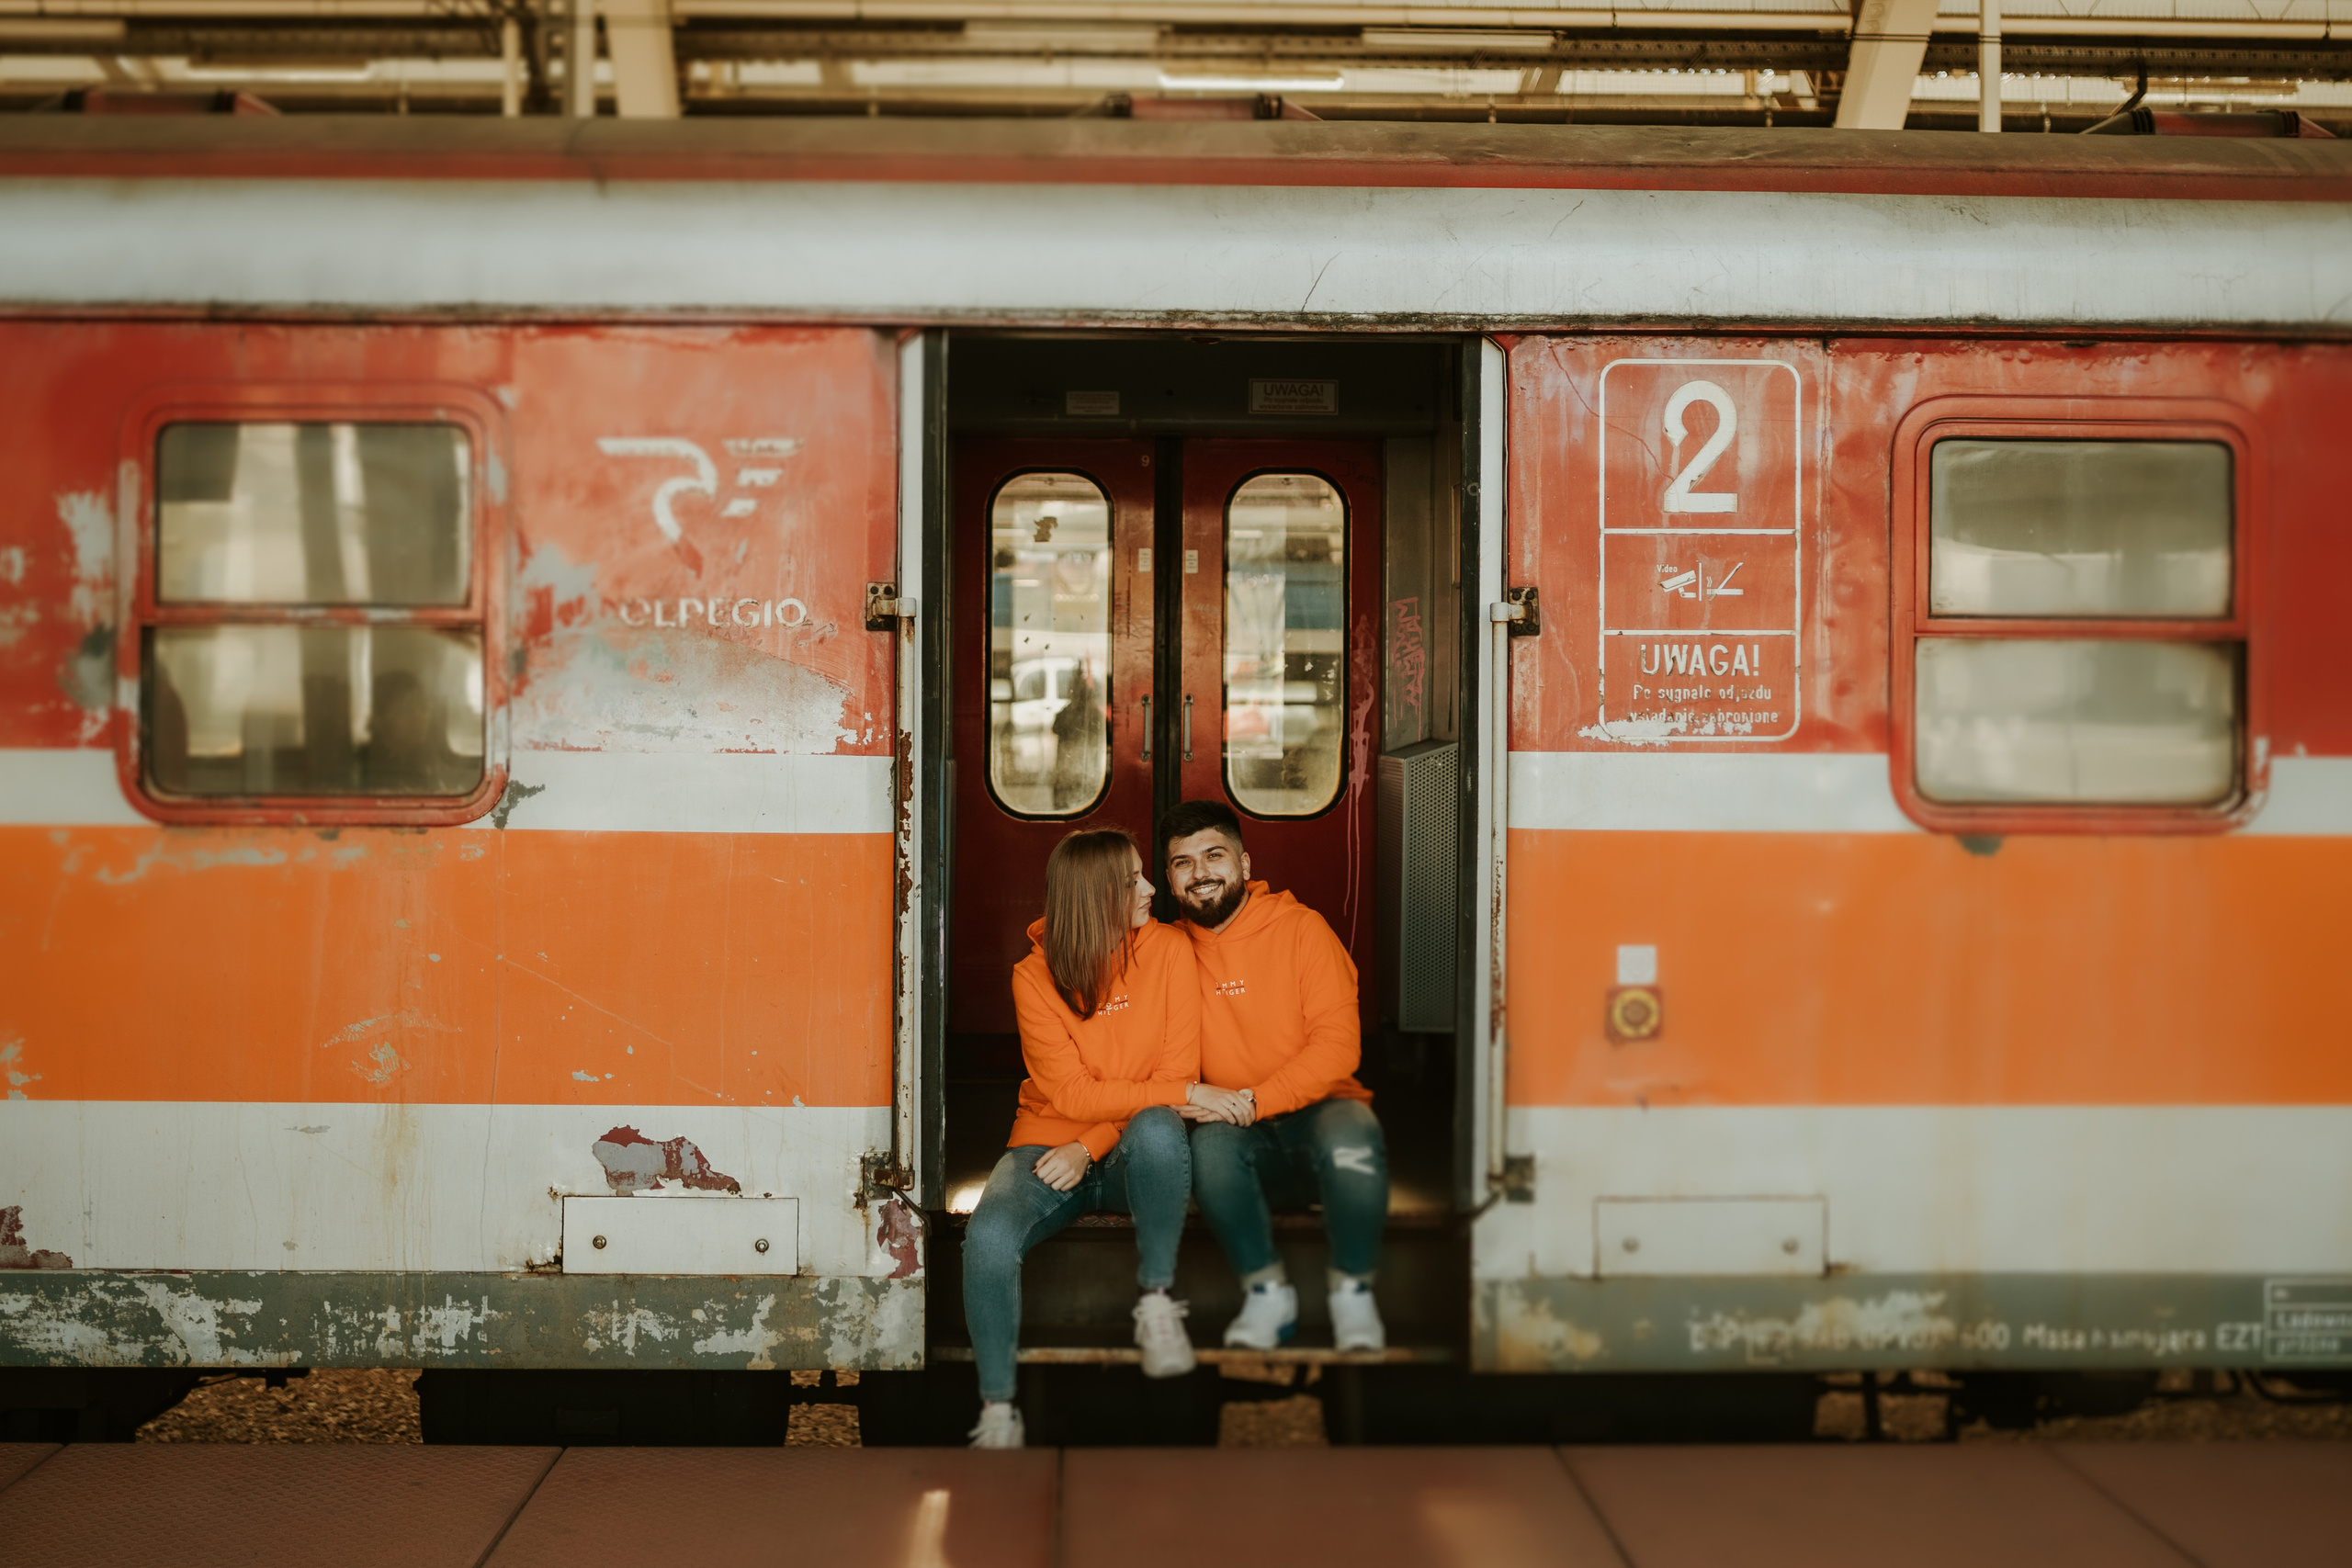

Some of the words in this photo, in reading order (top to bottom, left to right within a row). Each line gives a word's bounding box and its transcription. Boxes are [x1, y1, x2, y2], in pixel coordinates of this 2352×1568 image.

[1263, 383, 1324, 396] UWAGA!
[1663, 379, 1738, 513] 2
[1657, 564, 1679, 573] Video
[1640, 644, 1759, 676] UWAGA!
[1633, 684, 1651, 700] Po
[1719, 684, 1771, 703] odjazdu
[2022, 1322, 2086, 1351] Masa
[2215, 1322, 2264, 1351] EZT
